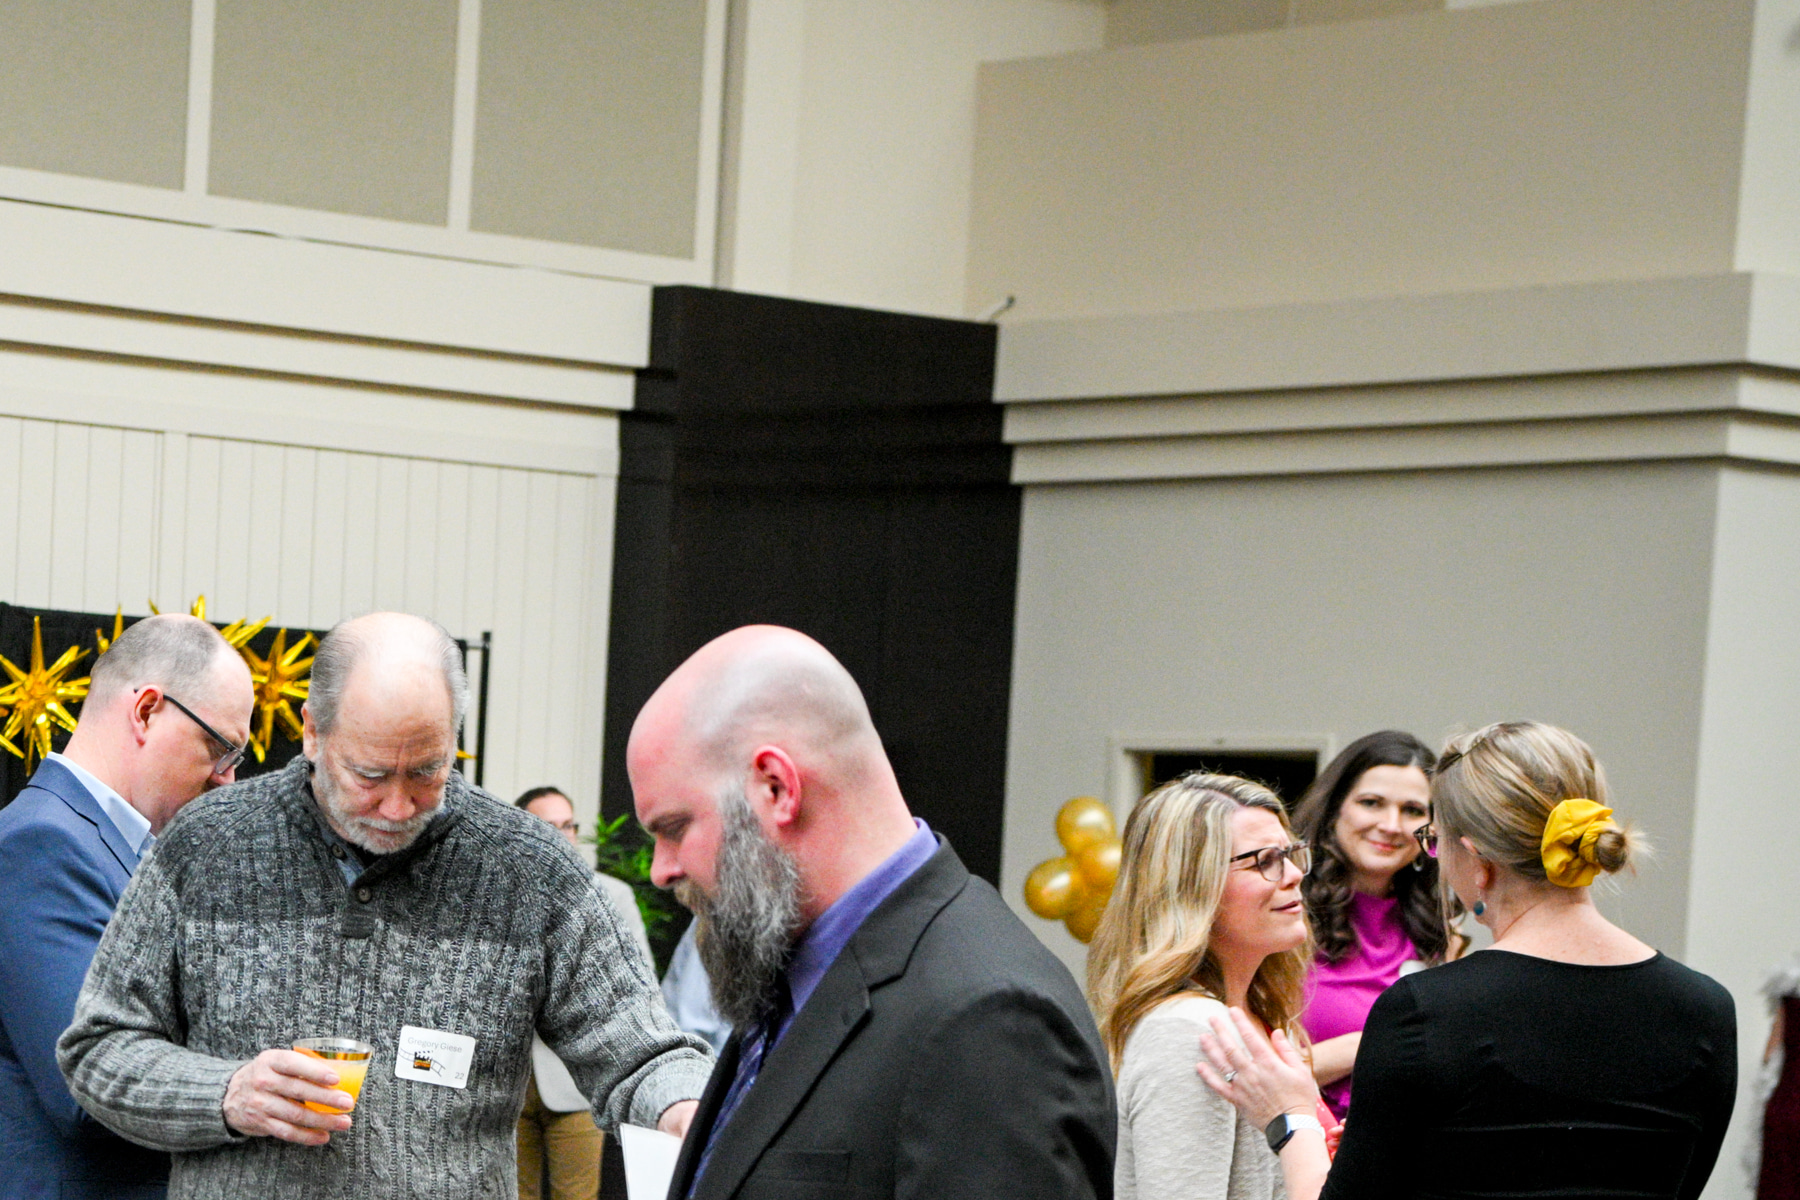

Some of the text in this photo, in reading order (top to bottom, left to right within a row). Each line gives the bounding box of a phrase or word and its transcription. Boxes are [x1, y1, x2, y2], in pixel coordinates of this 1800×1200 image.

[407, 1036, 463, 1053] Gregory Giese
[454, 1072, 464, 1080] 22
